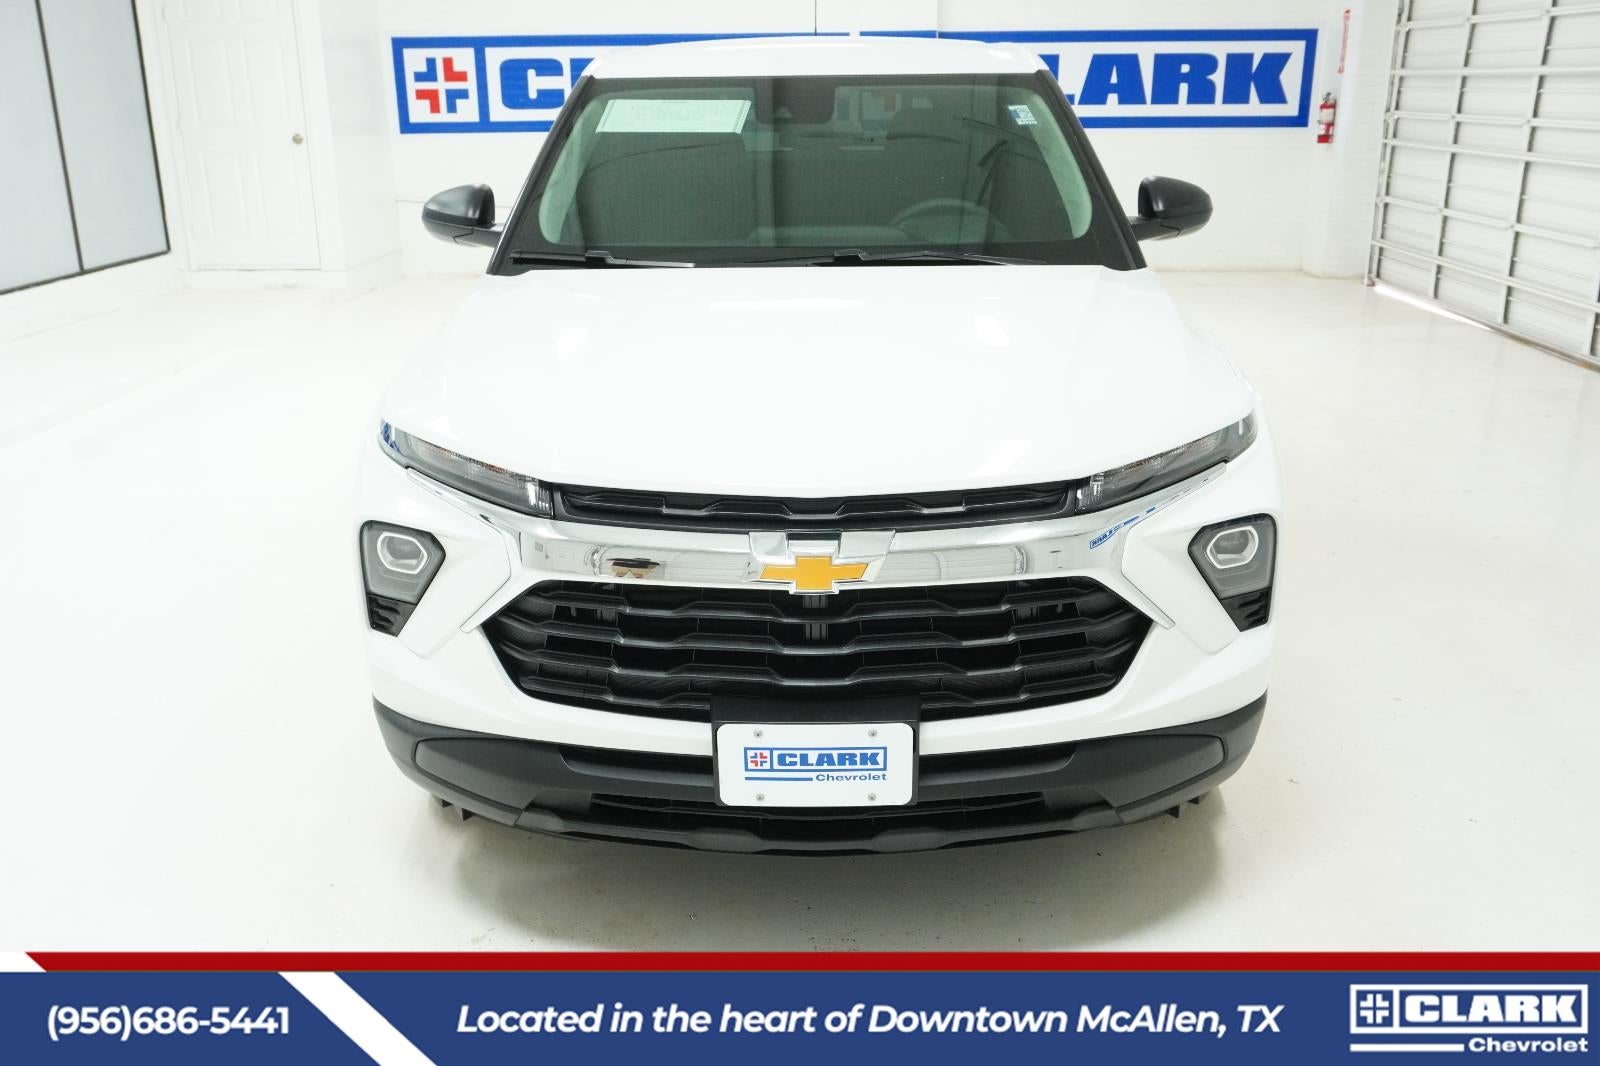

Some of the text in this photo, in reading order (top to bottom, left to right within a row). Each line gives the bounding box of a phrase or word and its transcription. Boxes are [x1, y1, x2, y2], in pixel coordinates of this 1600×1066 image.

[1038, 52, 1293, 105] ARK
[777, 752, 880, 767] CLARK
[815, 772, 887, 782] Chevrolet
